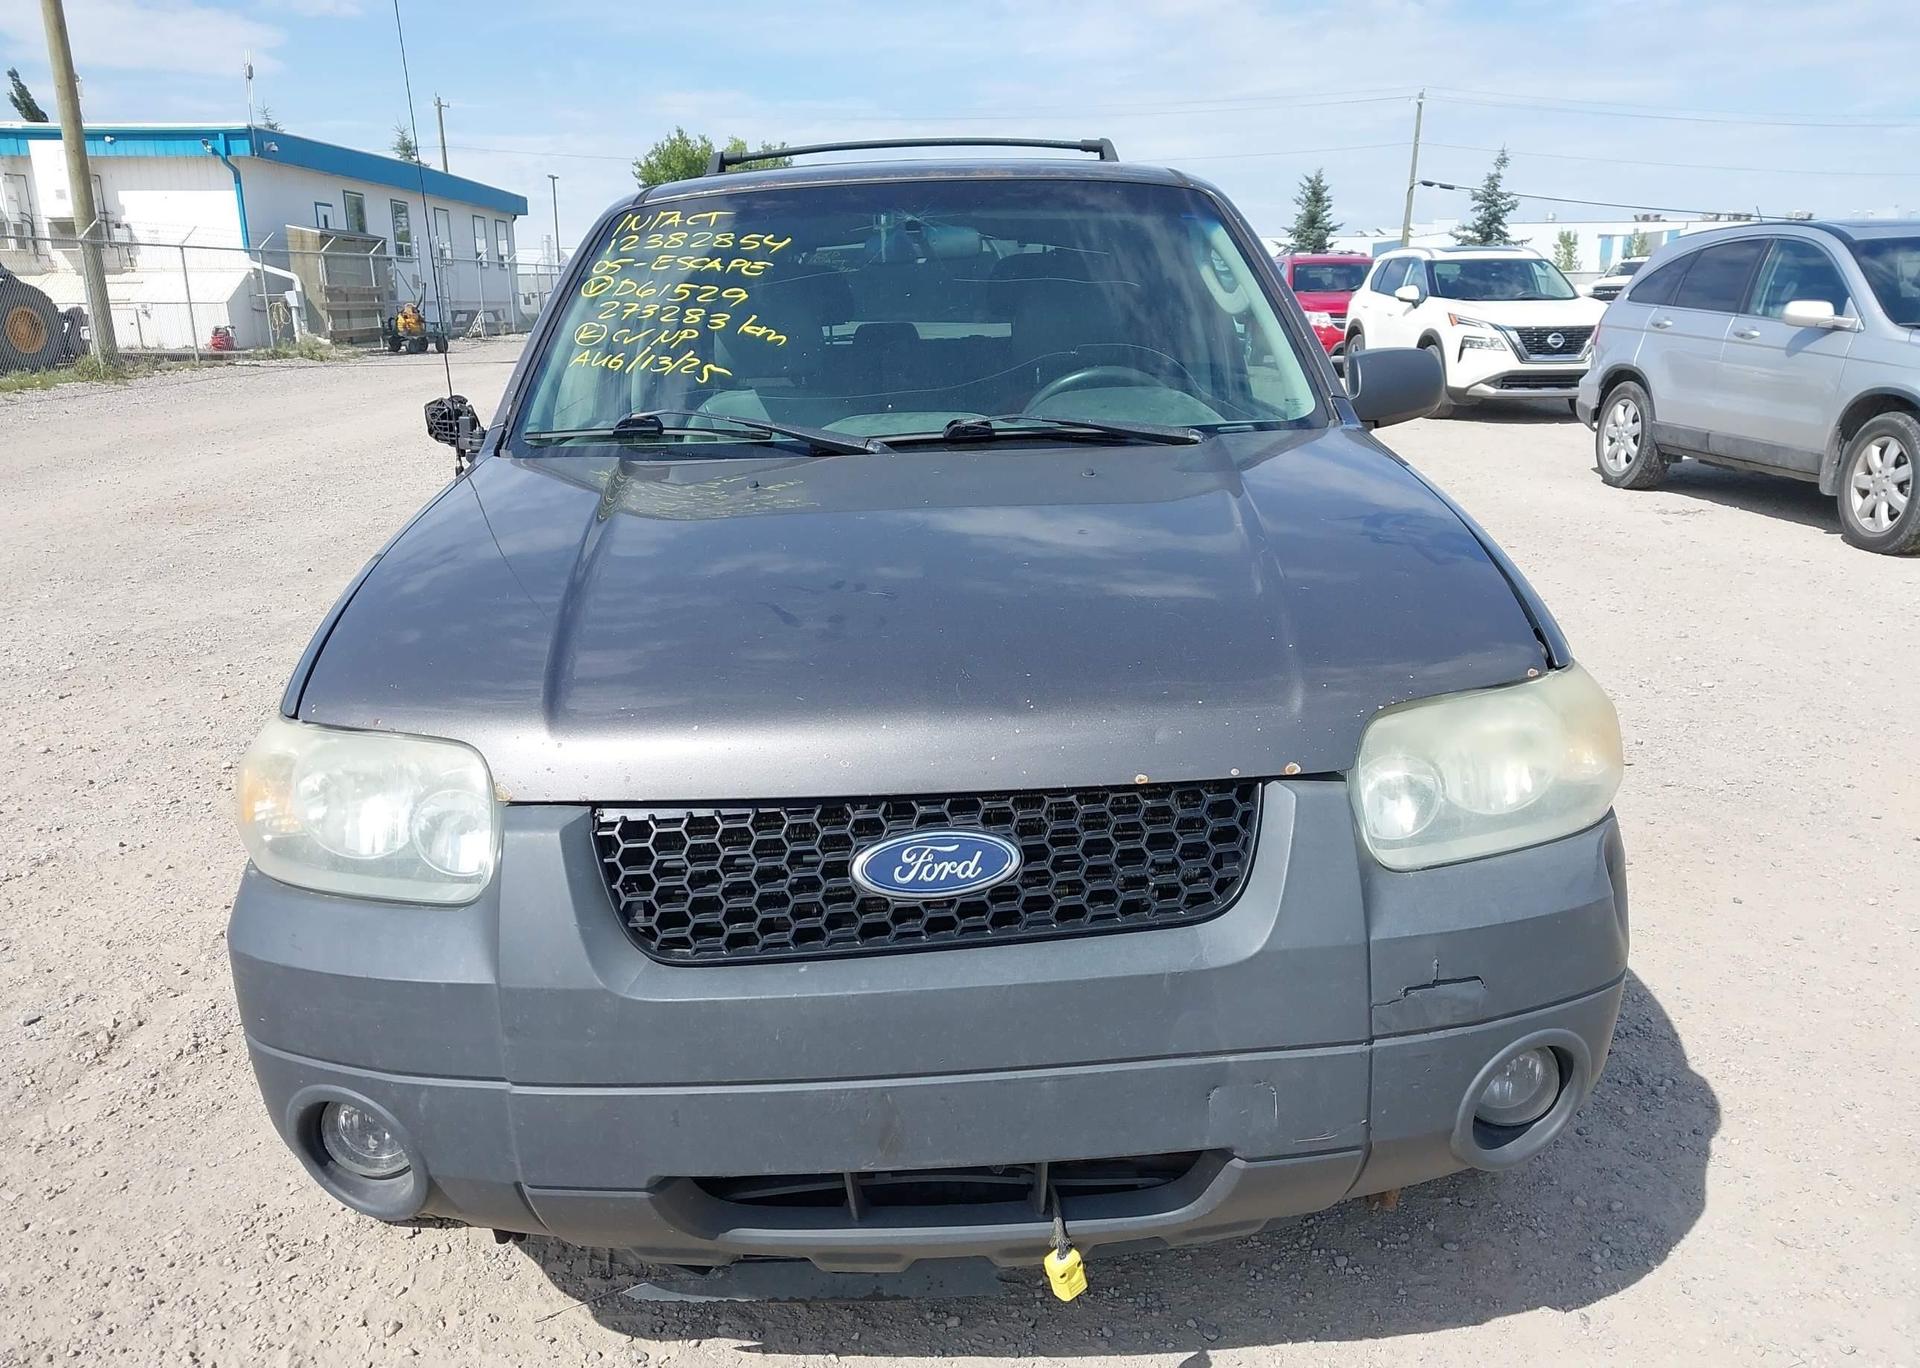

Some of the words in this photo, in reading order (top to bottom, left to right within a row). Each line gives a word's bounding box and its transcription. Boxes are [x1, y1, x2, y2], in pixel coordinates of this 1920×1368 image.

[614, 211, 736, 237] INTACT
[606, 232, 792, 254] 12382854
[598, 301, 731, 330] 273283
[894, 844, 983, 884] Ford
